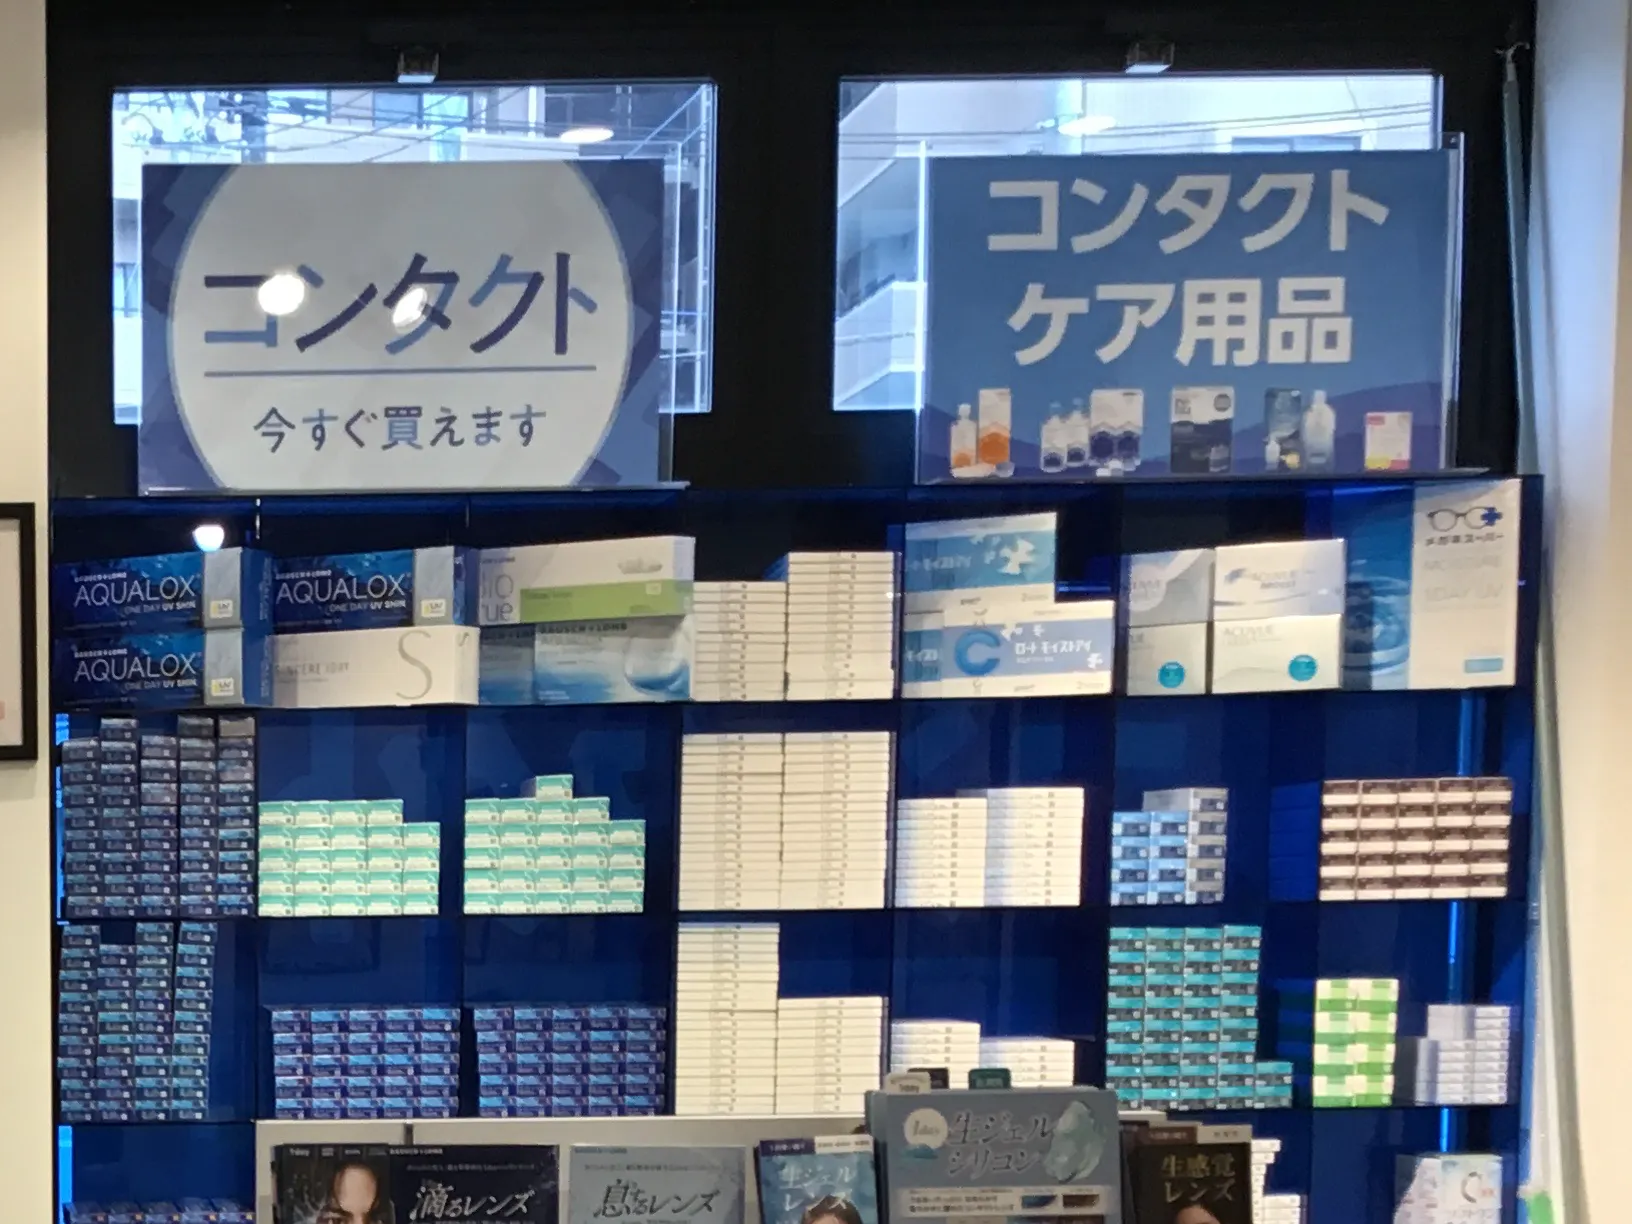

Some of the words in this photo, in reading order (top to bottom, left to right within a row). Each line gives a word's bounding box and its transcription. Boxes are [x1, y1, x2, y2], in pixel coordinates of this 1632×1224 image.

[986, 168, 1390, 254] コンタクト
[204, 251, 598, 356] コンタクト
[1007, 275, 1354, 367] ケア用品
[253, 402, 547, 453] 今すぐ買えます
[73, 575, 196, 608] AQUALOX
[276, 574, 406, 605] AQUALOX
[74, 652, 197, 683] AQUALOX
[946, 1111, 1059, 1146] 生ジェル
[947, 1148, 1045, 1180] シリコン
[1161, 1152, 1236, 1179] 生感覚
[1164, 1178, 1236, 1203] レンズ
